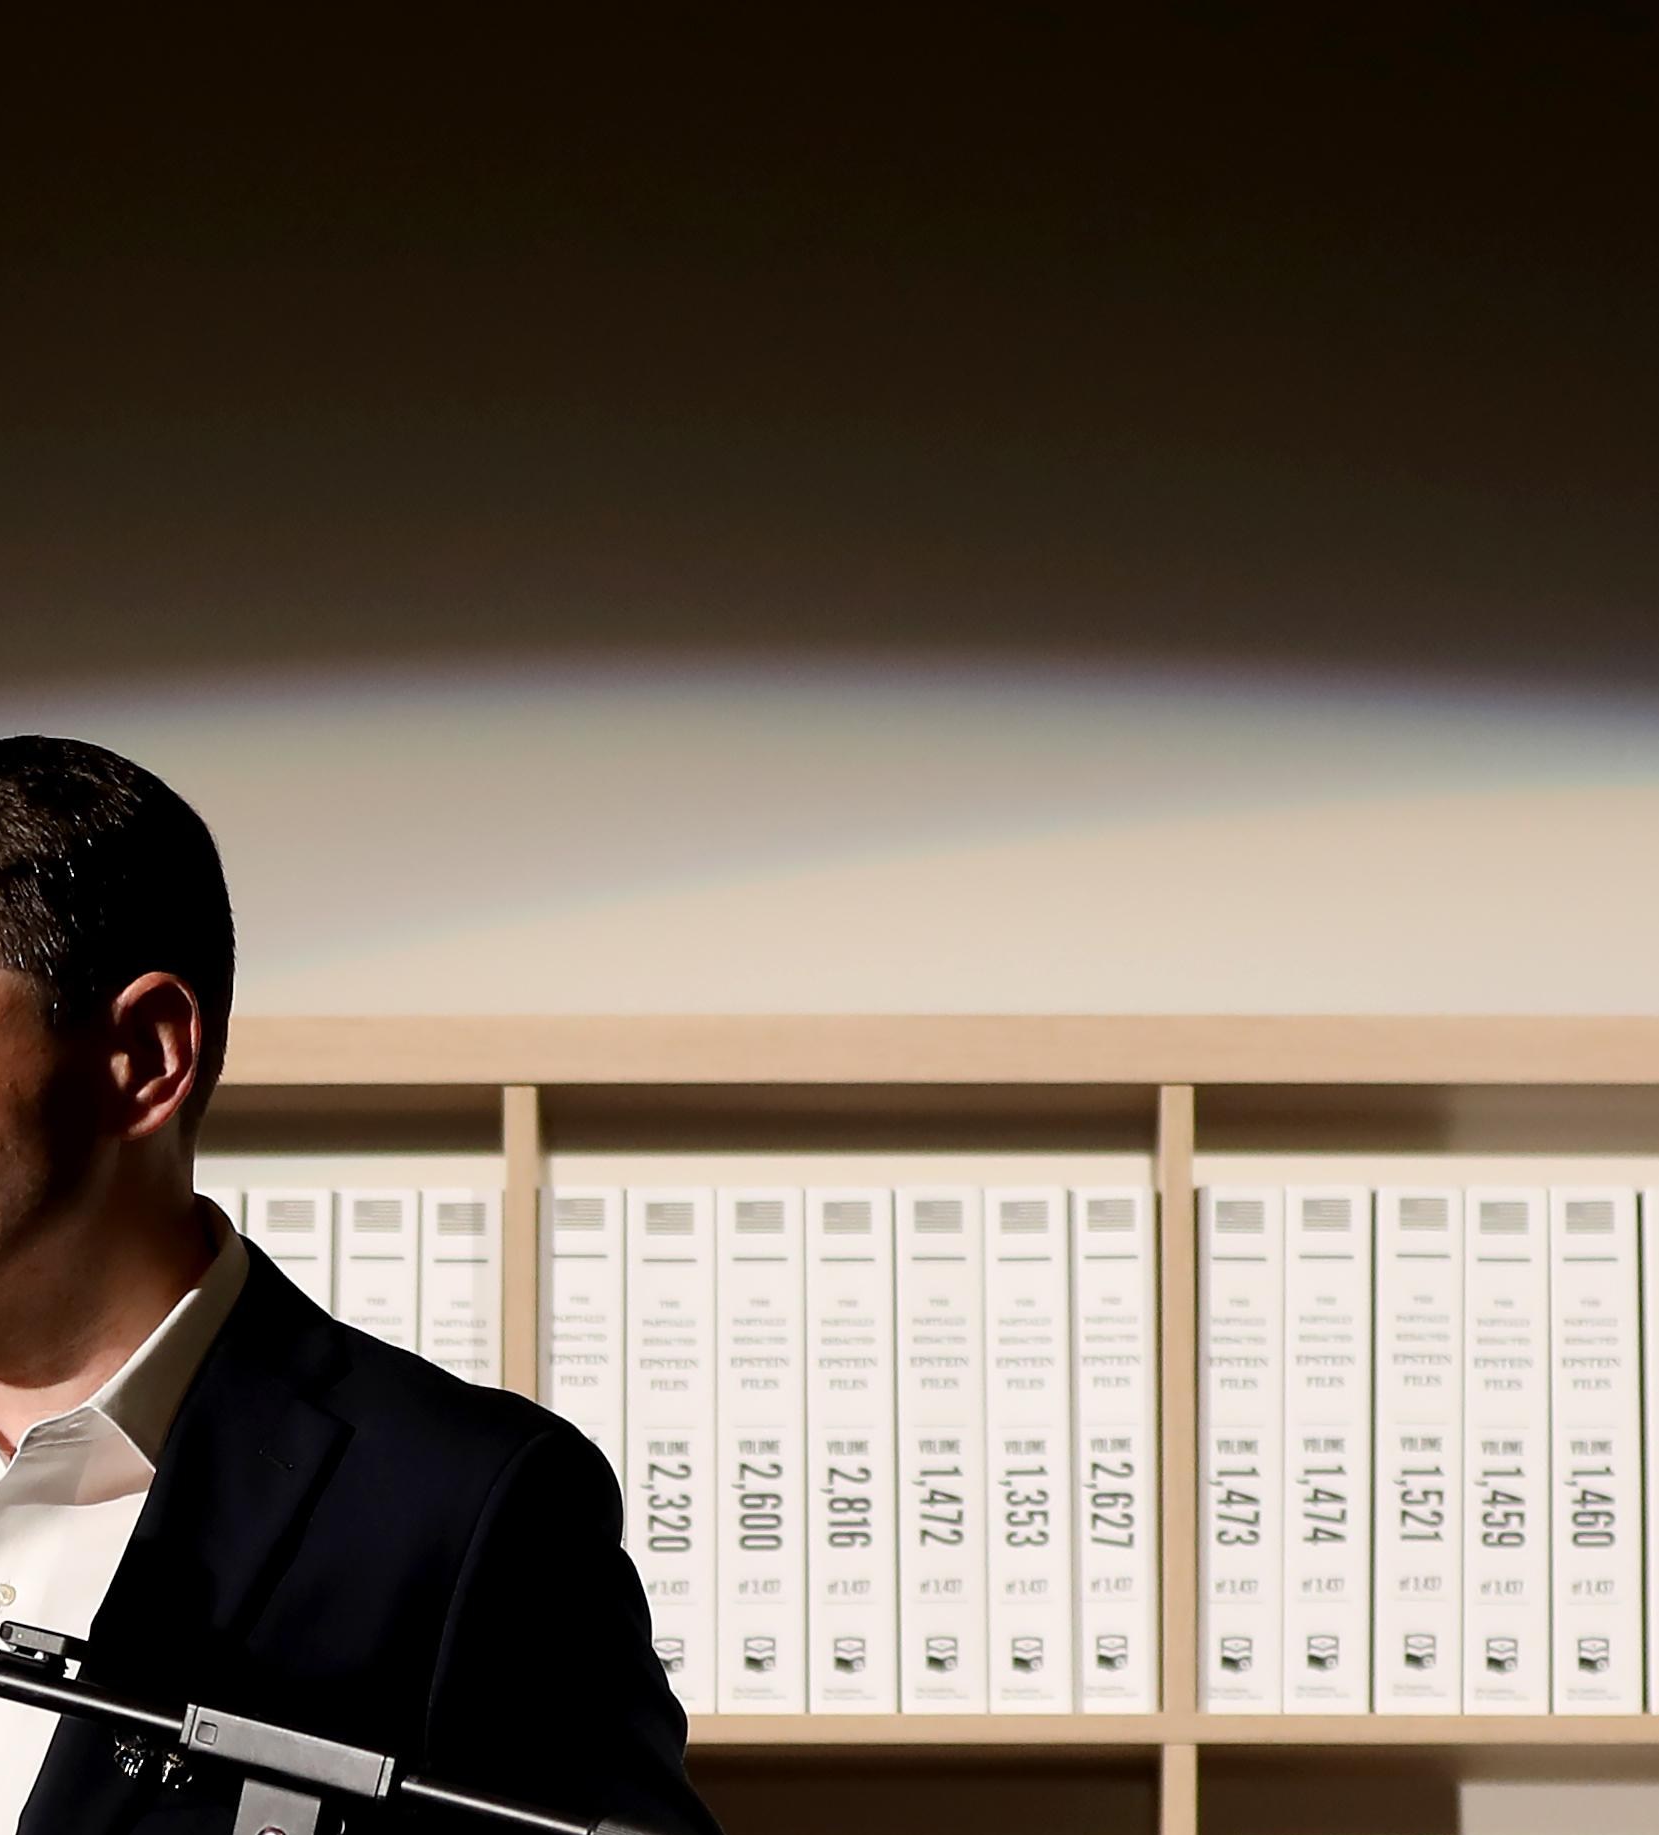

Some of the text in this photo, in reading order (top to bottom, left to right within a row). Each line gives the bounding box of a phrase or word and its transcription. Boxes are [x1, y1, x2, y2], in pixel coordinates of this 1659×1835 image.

[642, 1463, 692, 1552] 2,320
[732, 1463, 783, 1551] 2,600
[821, 1467, 872, 1548] 2,816
[913, 1466, 964, 1546] 1,472
[999, 1466, 1049, 1547] 1,353
[1084, 1462, 1134, 1548] 2,627
[1209, 1466, 1268, 1546] 1,473
[1297, 1465, 1347, 1545] 1,474
[1394, 1466, 1444, 1541] 1,521
[1476, 1467, 1525, 1547] 1,459
[1565, 1466, 1615, 1547] 1,460
